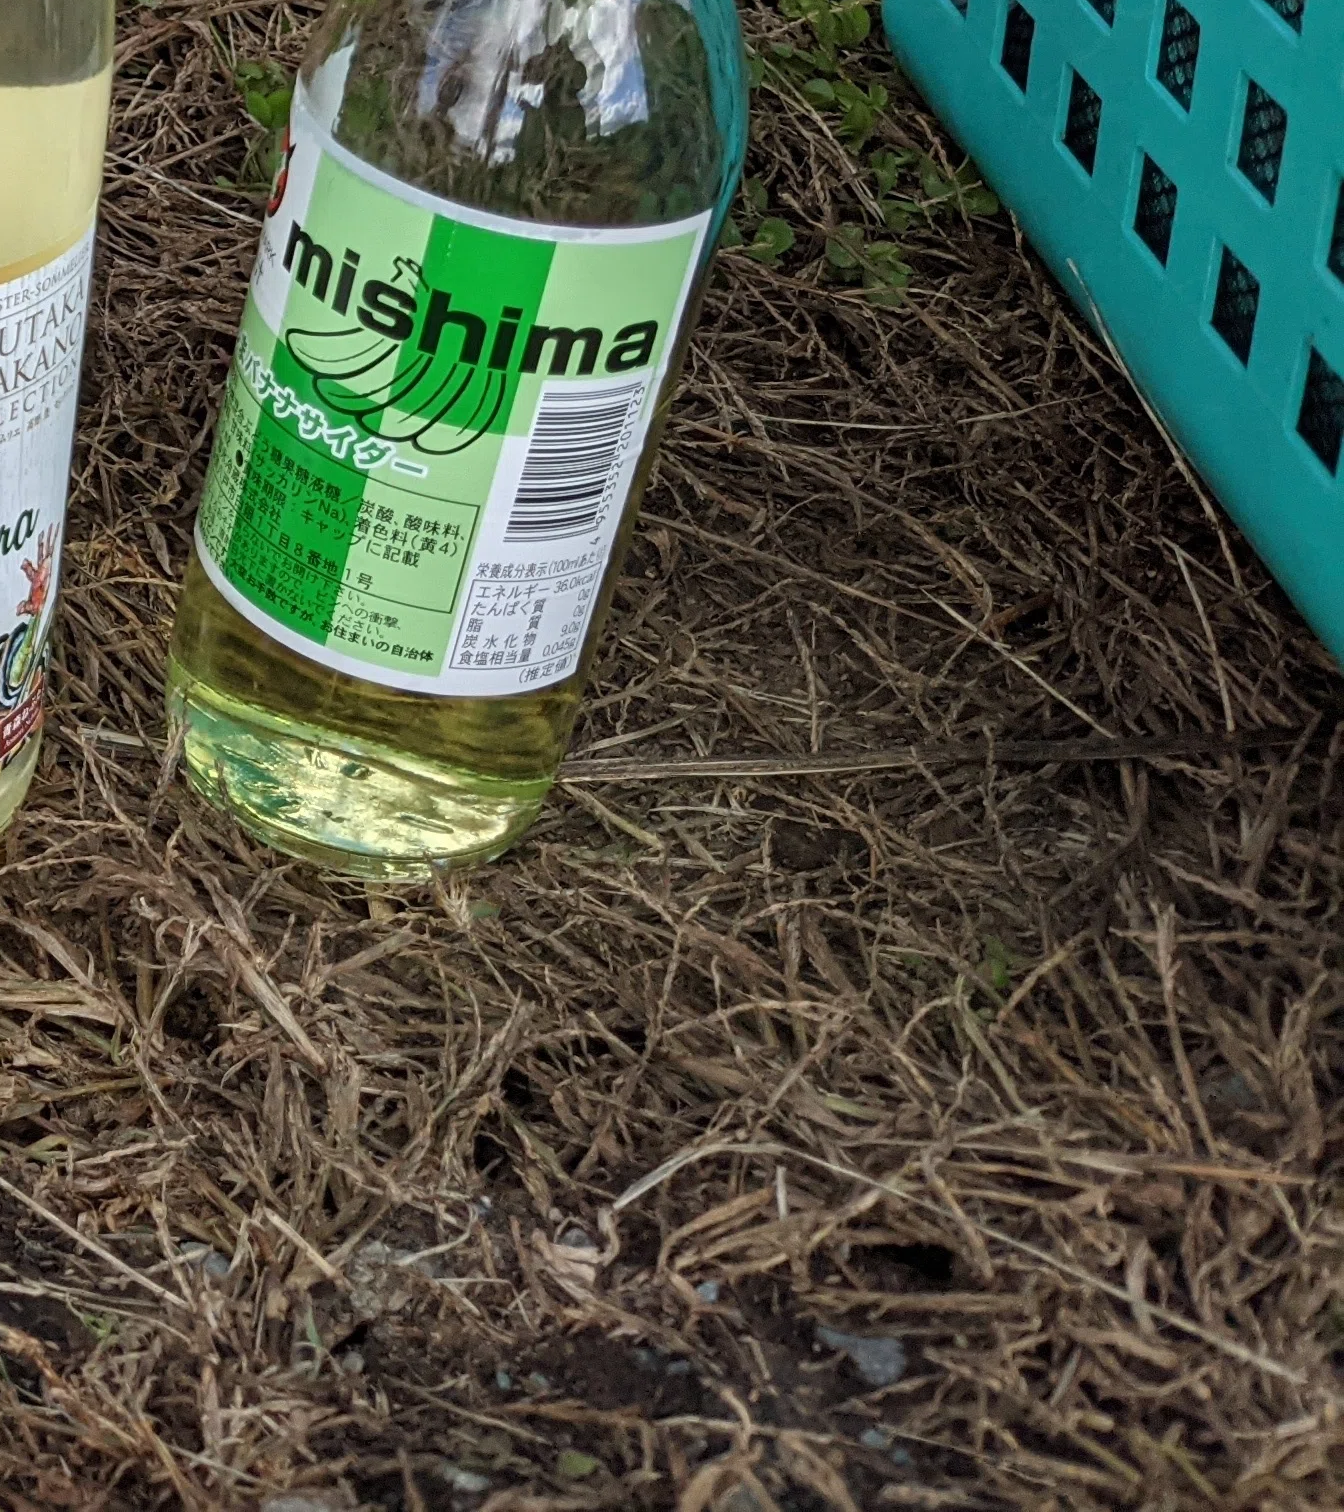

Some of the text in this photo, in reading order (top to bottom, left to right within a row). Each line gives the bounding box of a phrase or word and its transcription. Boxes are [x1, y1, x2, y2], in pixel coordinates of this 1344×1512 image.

[282, 220, 659, 376] mishima
[475, 582, 551, 600] エネルギー
[470, 598, 547, 617] たんぱく質
[461, 632, 537, 649] 炭水化物
[457, 647, 532, 666] 食塩相当量
